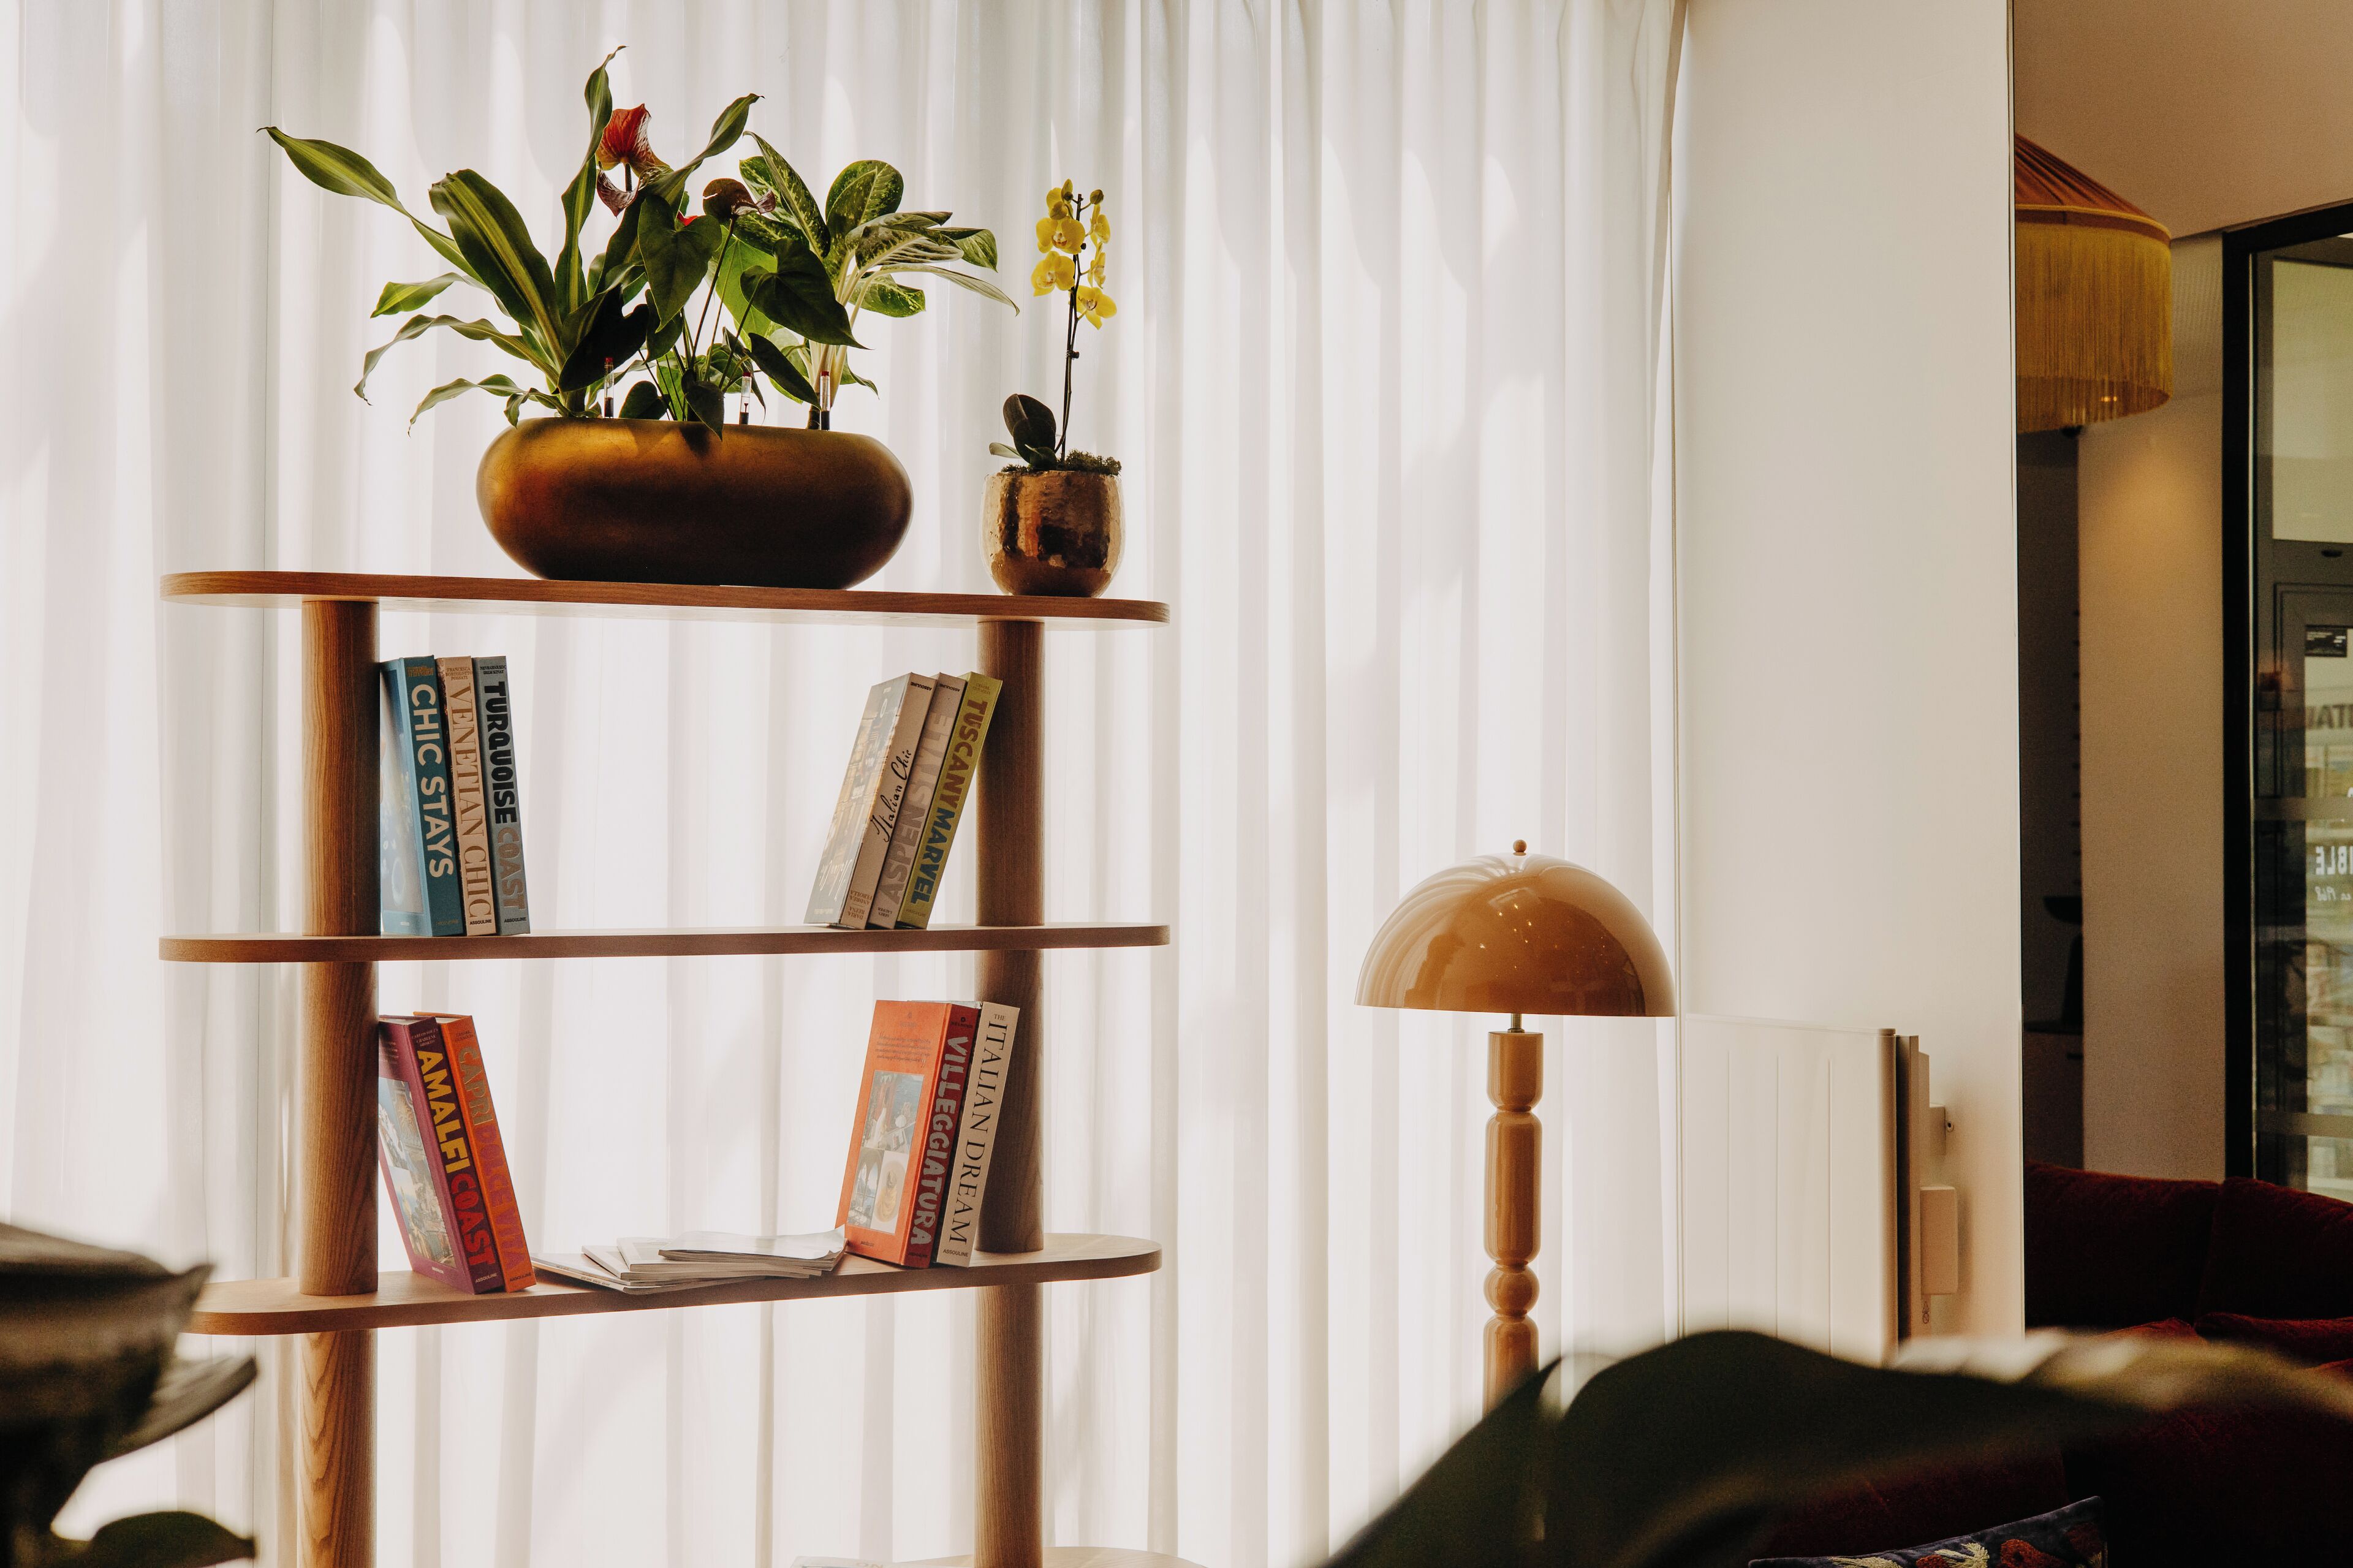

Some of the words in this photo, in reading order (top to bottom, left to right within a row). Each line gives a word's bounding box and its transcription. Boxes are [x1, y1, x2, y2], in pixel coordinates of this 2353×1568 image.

[411, 684, 442, 766] CHIC
[911, 681, 932, 691] ASSOULINE
[939, 683, 960, 692] ASSOULINE
[450, 683, 485, 837] VENETIAN
[484, 681, 517, 824] TURQUOISE
[940, 699, 988, 809] TUSCANY
[420, 776, 453, 878] STAYS
[870, 786, 903, 843] Italian
[892, 749, 912, 781] Chic
[877, 800, 926, 905] ASPEN
[909, 711, 953, 801] STYLE
[463, 845, 492, 918] CHIC
[496, 827, 526, 911] COAST
[911, 807, 956, 904] MARVEL
[847, 911, 864, 920] DARIA
[849, 895, 870, 904] ANDREA
[849, 906, 865, 915] REINA
[458, 1047, 493, 1126] CAPRI
[972, 1021, 1008, 1134] ITALIAN
[417, 1050, 471, 1175] AMALFI
[450, 1173, 495, 1266] COAST
[474, 1125, 513, 1207] DOLCE
[910, 1036, 969, 1246] VILLEGGIATURA
[949, 1139, 986, 1245] DREAM
[475, 1272, 498, 1283] ASSOULINE
[495, 1209, 527, 1271] VITA
[943, 1248, 968, 1258] ASSOULINE
